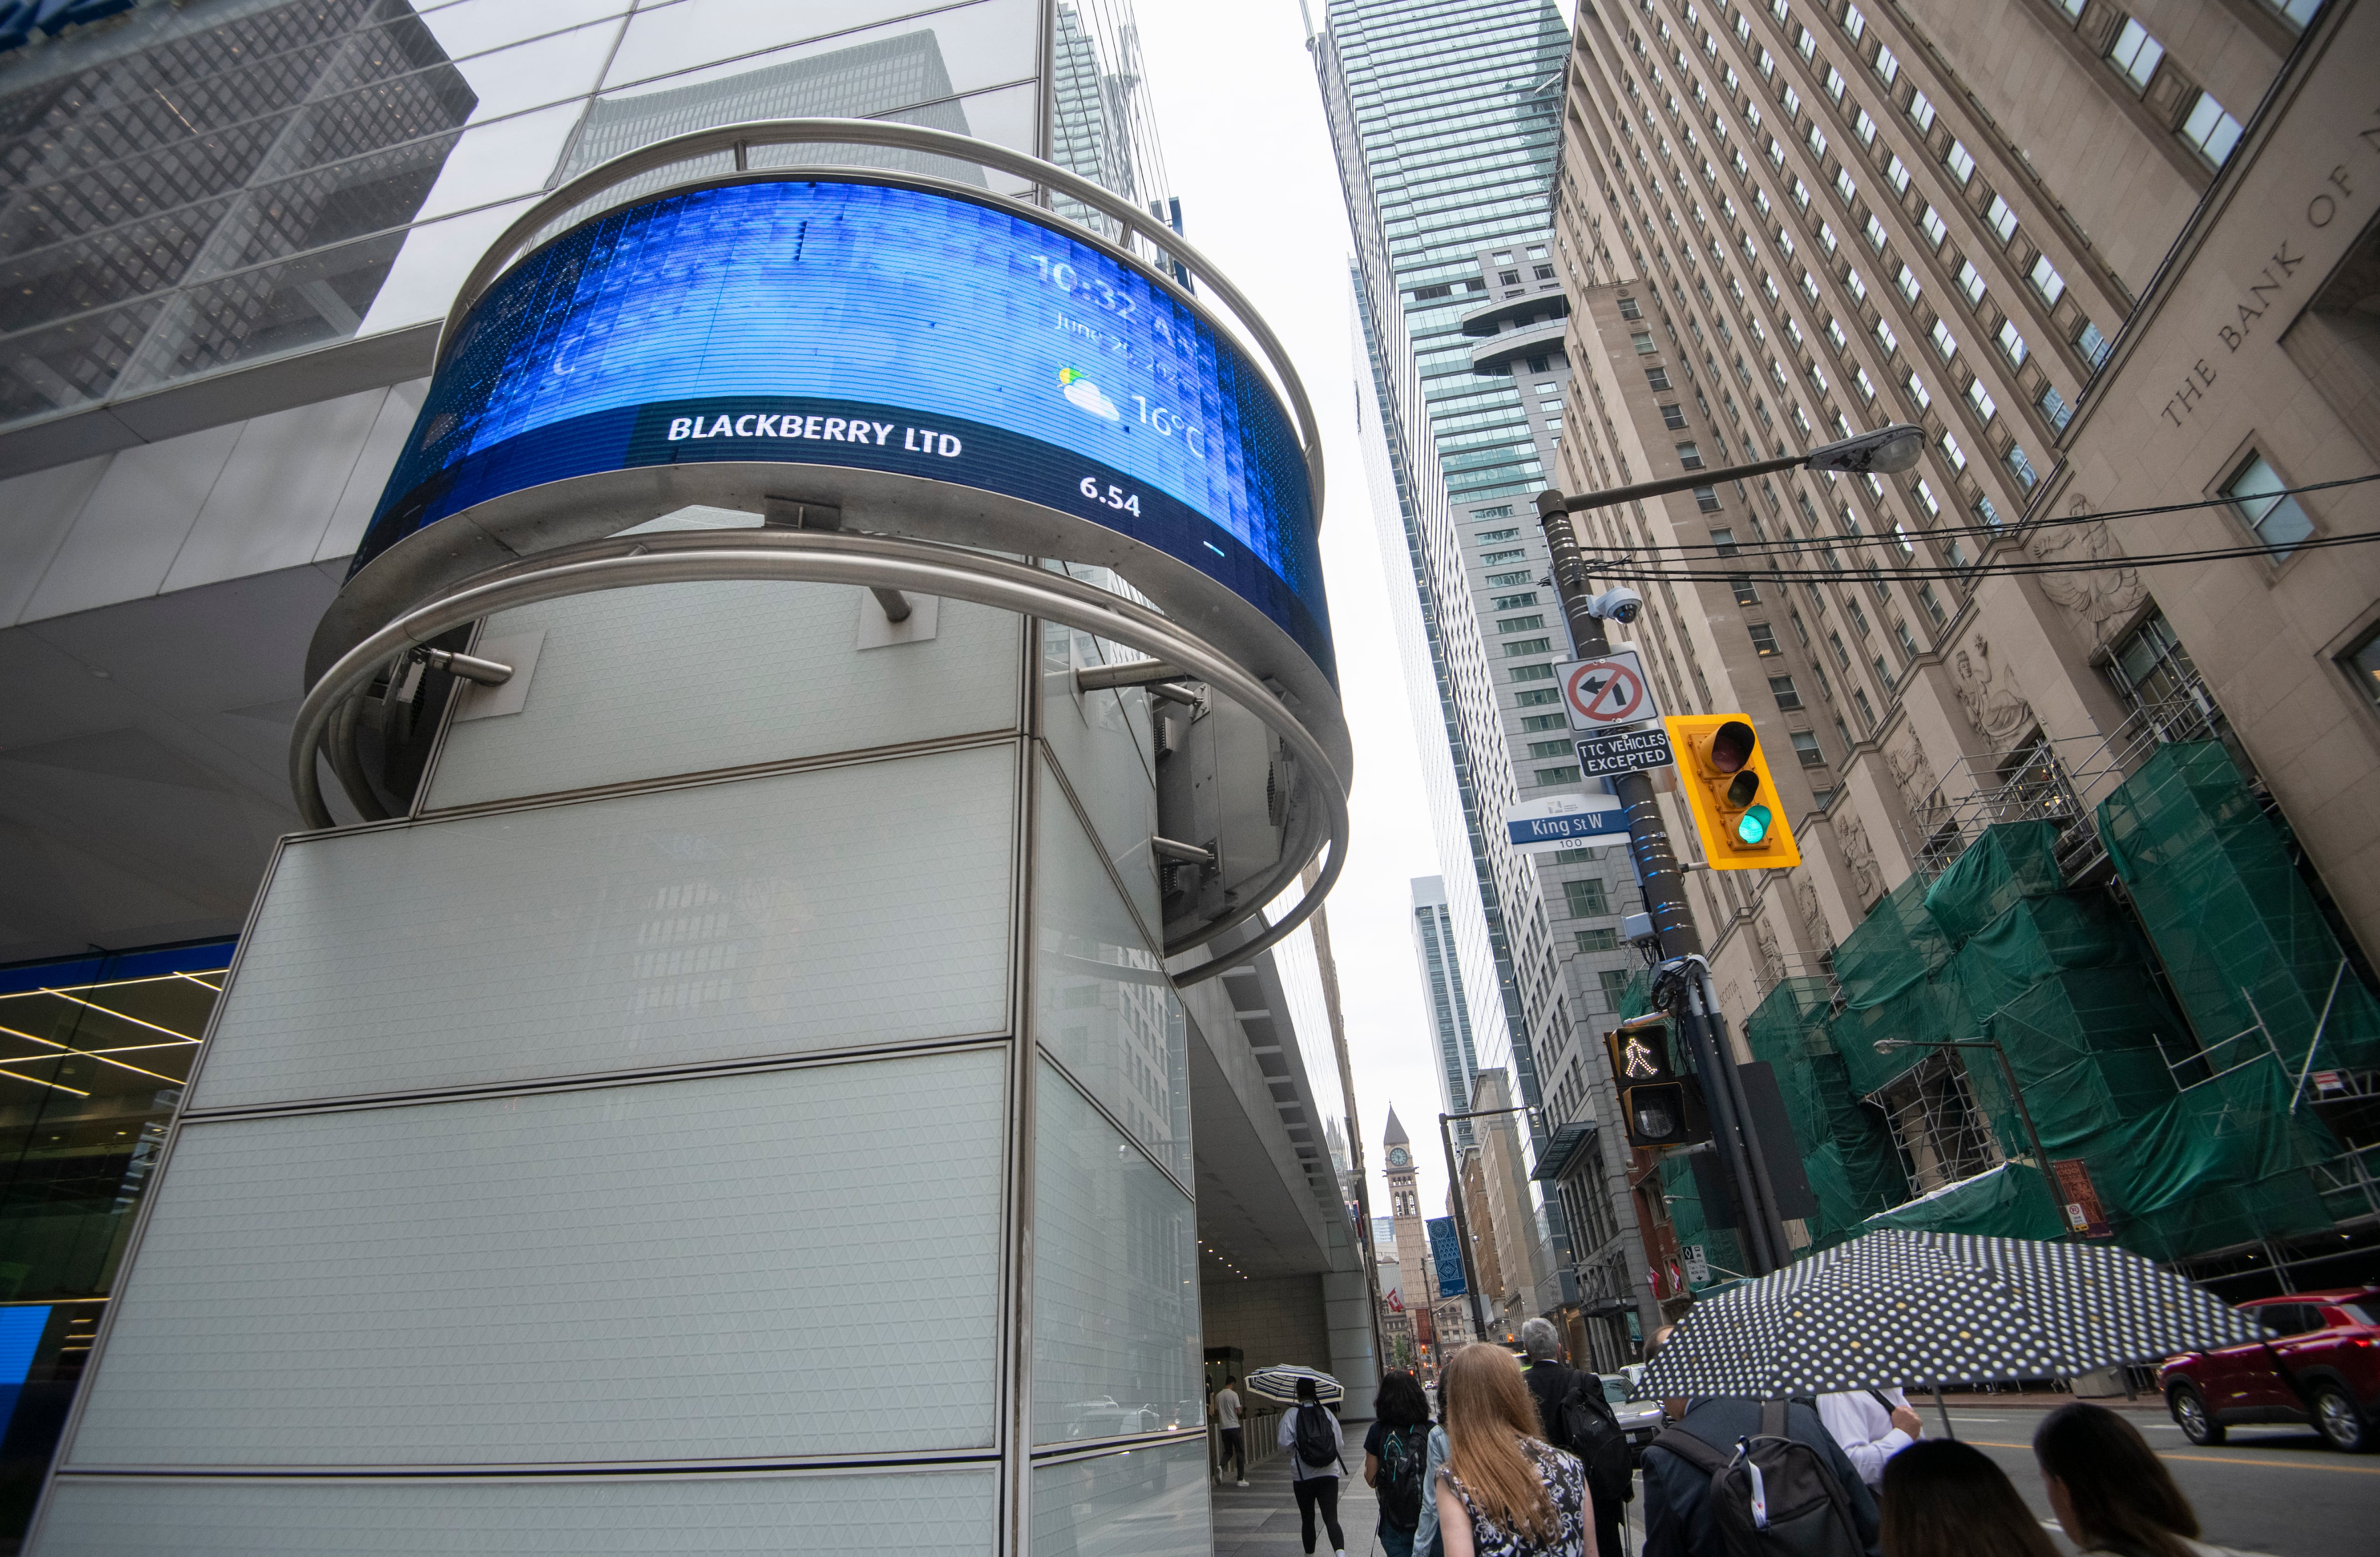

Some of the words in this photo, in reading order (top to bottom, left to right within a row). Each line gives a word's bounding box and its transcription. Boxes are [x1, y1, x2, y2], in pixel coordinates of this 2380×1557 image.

[1030, 255, 1137, 325] 10:32
[2161, 359, 2217, 428] THE
[2218, 240, 2305, 353] BANK
[2308, 164, 2352, 228] OF
[1054, 312, 1103, 345] June
[667, 414, 894, 446] BLACKBERRY
[904, 427, 962, 457] LTD
[1131, 396, 1204, 459] 16°C
[1080, 476, 1141, 518] 6.54
[1579, 743, 1605, 758] TTC
[1608, 733, 1666, 753] VEHICLES
[1587, 749, 1666, 772] EXCEPTED
[1532, 819, 1570, 836] King
[1573, 818, 1587, 831] St
[1587, 813, 1602, 829] W
[1559, 838, 1582, 848] 100
[1719, 979, 1739, 1007] SCOTIA
